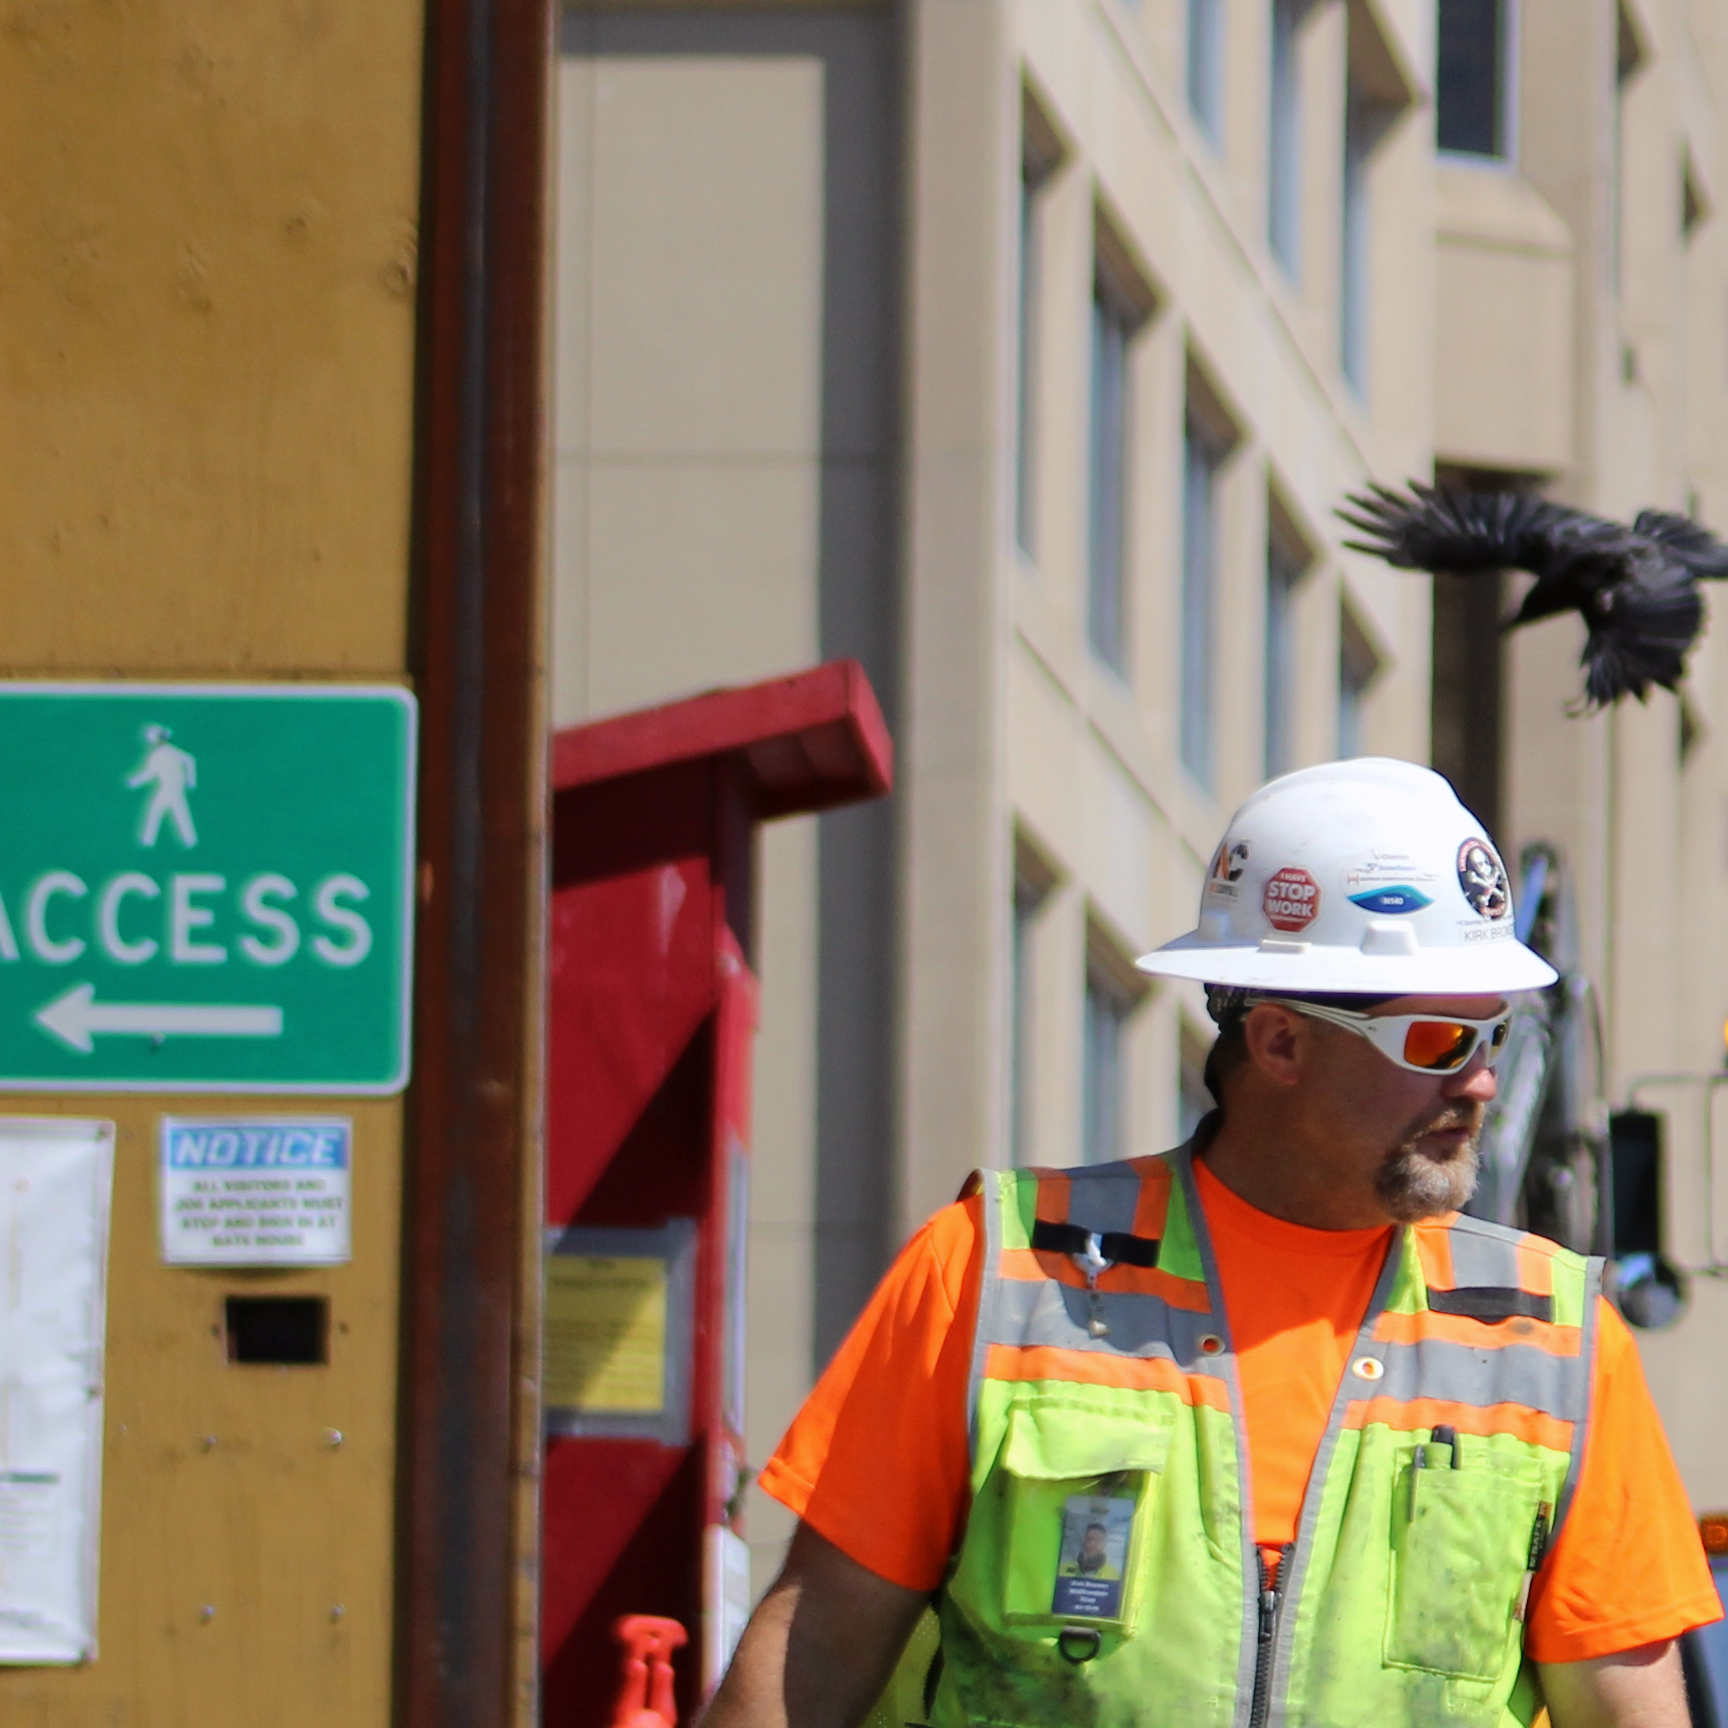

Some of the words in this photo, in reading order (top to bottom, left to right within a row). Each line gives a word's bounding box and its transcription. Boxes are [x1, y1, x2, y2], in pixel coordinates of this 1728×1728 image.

[1268, 881, 1316, 901] STOP
[1268, 899, 1314, 917] WORK
[1464, 928, 1489, 942] KIRK
[174, 1132, 341, 1165] NOTICE
